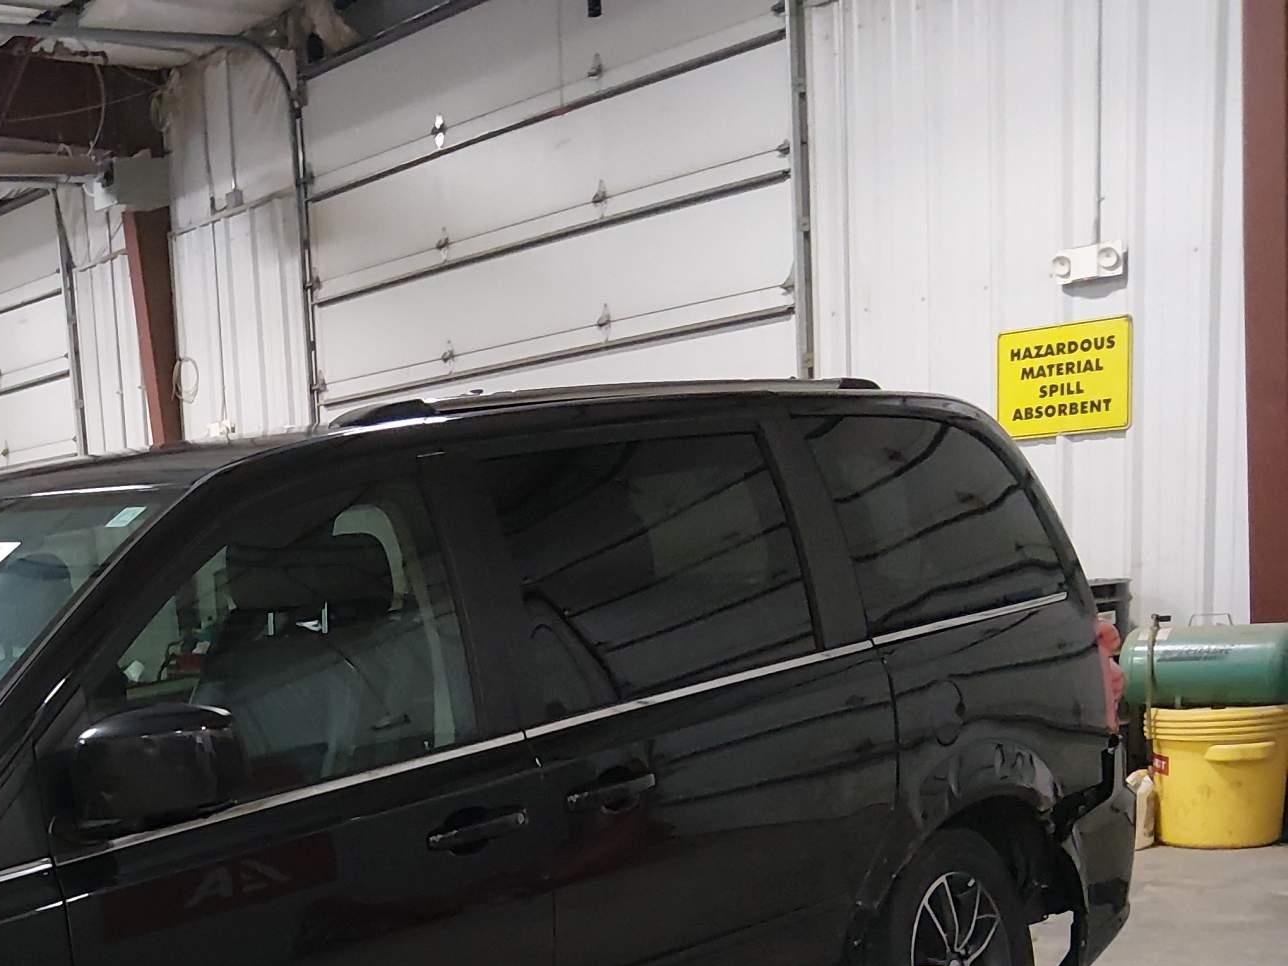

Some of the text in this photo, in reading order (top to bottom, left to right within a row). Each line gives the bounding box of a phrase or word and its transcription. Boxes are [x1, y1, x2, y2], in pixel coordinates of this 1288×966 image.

[1010, 335, 1116, 361] HAZARDOUS
[1020, 358, 1104, 380] MATERIAL
[1039, 381, 1085, 398] SPILL
[1012, 398, 1112, 421] ABSORBENT
